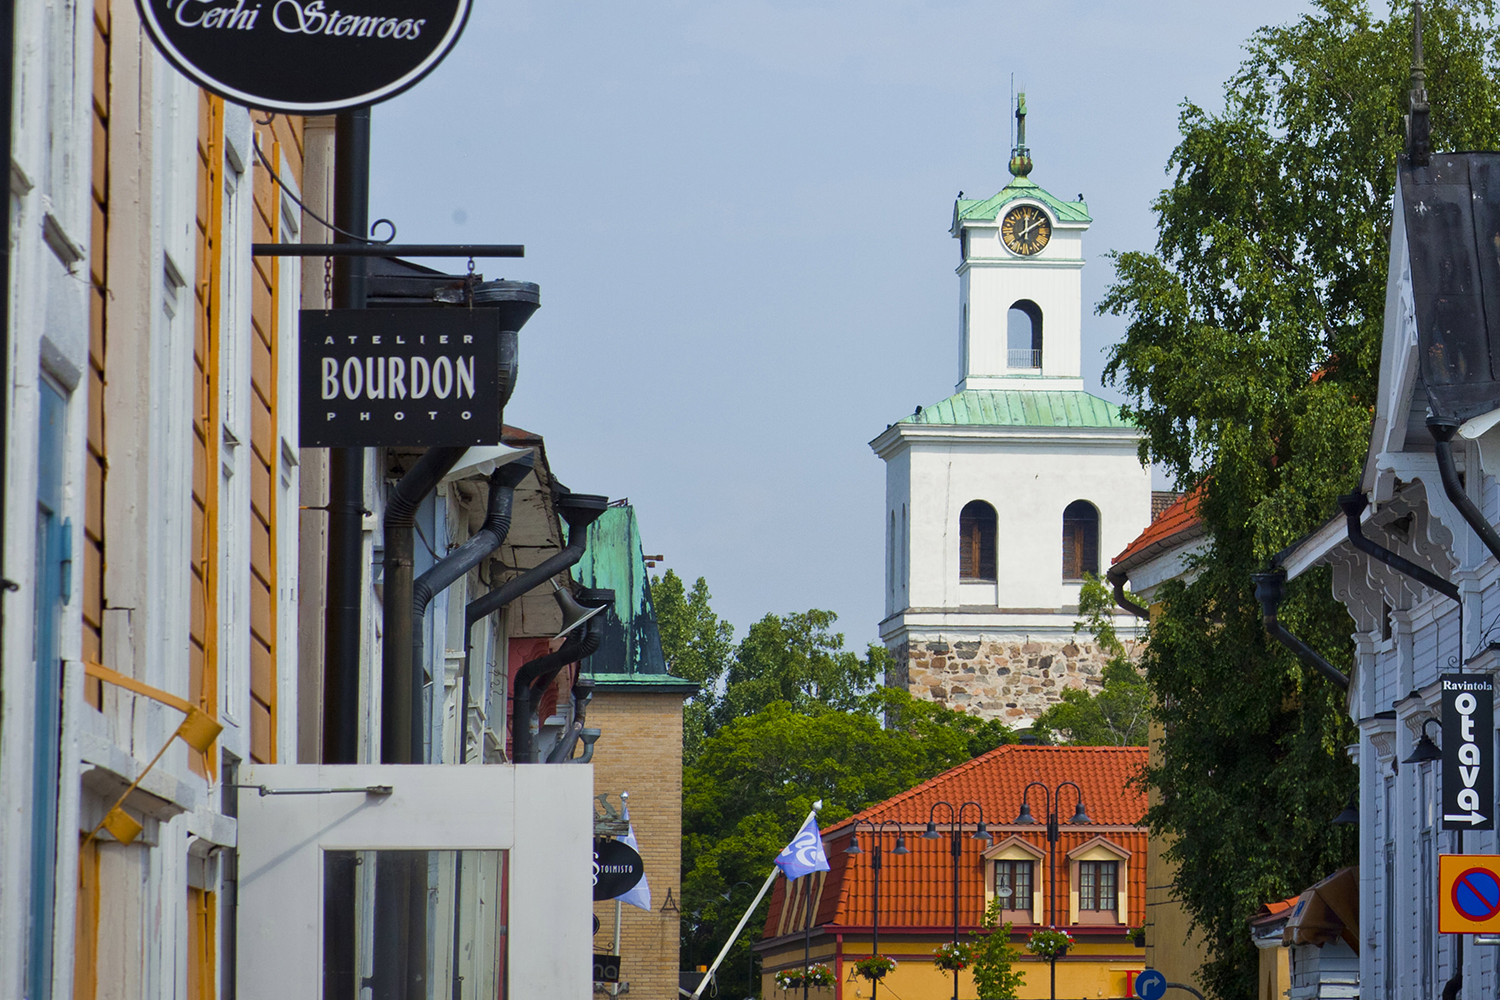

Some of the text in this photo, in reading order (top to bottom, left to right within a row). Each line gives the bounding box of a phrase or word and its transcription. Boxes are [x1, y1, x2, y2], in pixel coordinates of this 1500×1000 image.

[324, 334, 474, 345] ATELIER
[321, 355, 476, 400] BOURDON
[326, 410, 472, 421] PHOTO
[1443, 680, 1493, 691] Ravintola
[1454, 692, 1481, 811] otava
